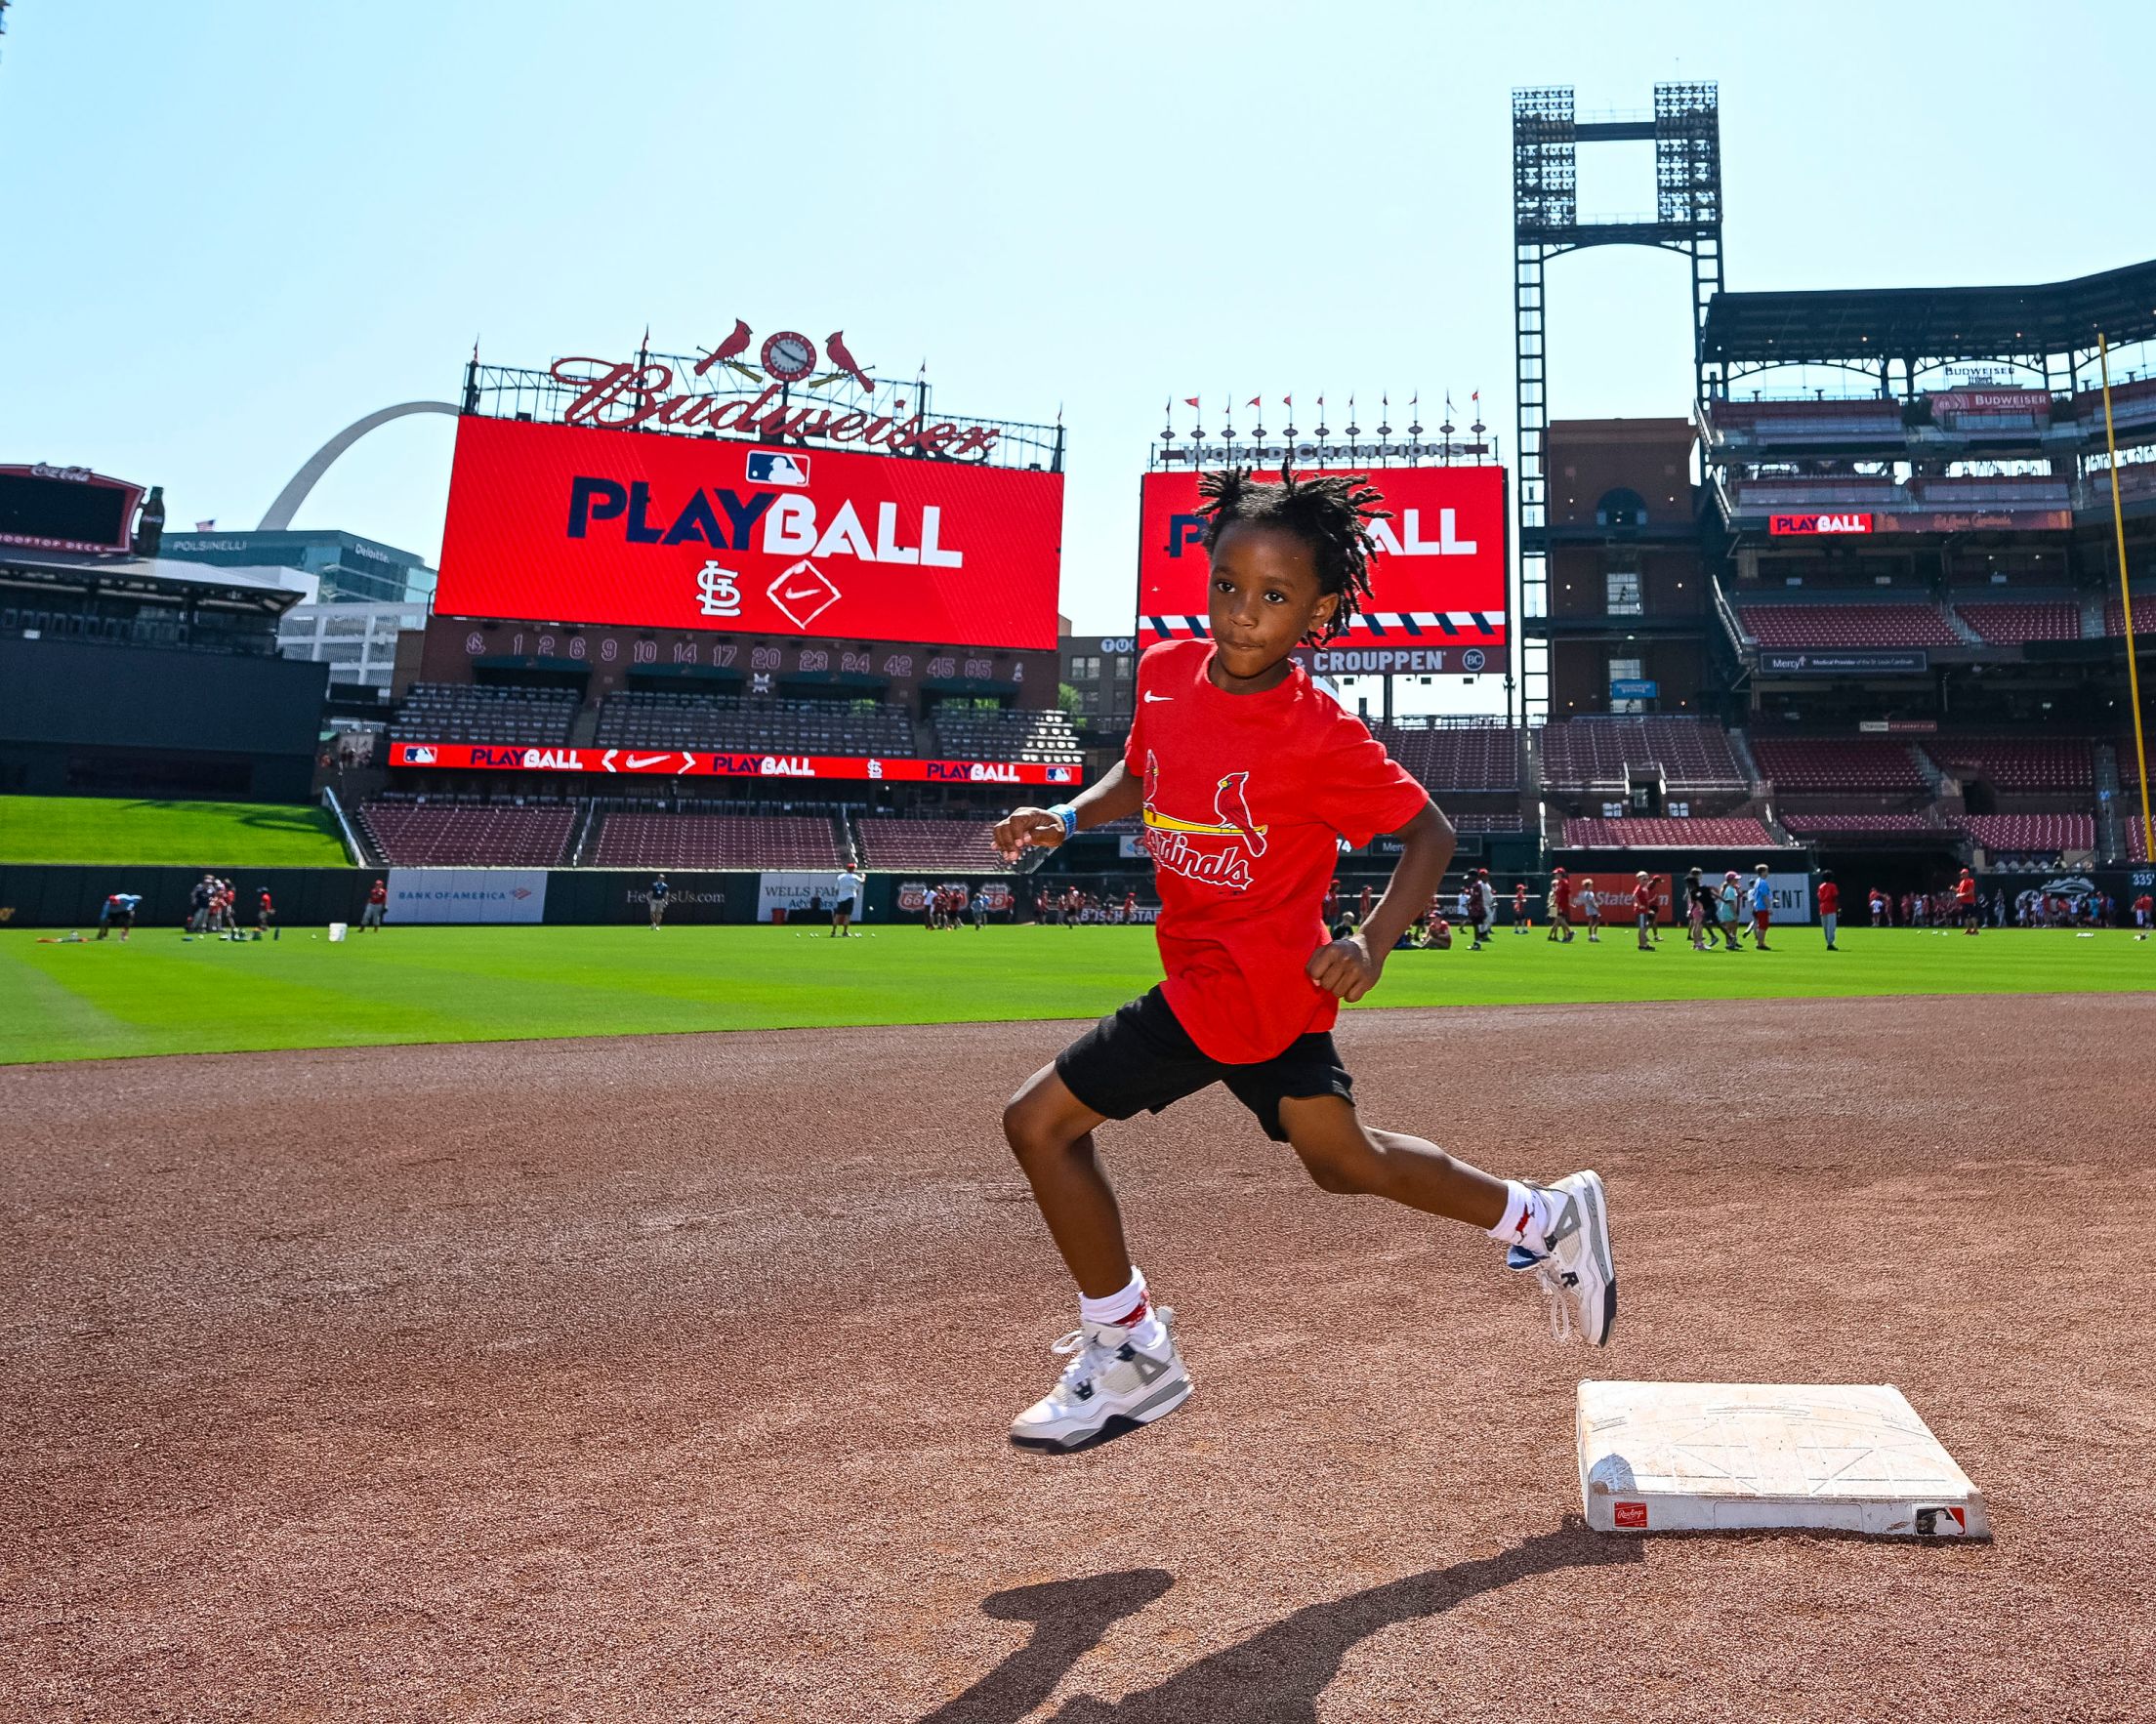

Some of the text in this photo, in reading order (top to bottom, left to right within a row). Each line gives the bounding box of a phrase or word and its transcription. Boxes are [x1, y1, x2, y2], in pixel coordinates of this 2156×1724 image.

[1945, 367, 2014, 376] BUDWEISER
[1975, 394, 2047, 406] BUDWEISER
[551, 356, 1001, 457] Budweiser
[1183, 443, 1466, 464] WORLD CHAMPIONS
[0, 534, 61, 547] OOFTOP
[174, 540, 247, 552] POLSINELLI
[514, 634, 522, 655] 1
[538, 636, 555, 657] 2
[601, 638, 617, 661] 9
[634, 640, 657, 663] 10
[674, 642, 697, 665] 14
[713, 644, 737, 667] 17
[751, 647, 781, 670] 20
[799, 649, 828, 672] 23
[842, 652, 870, 674] 24
[884, 655, 912, 677] 42
[928, 657, 955, 678] 45
[1313, 651, 1443, 671] CROUPPEN
[1772, 658, 1800, 671] Mercy
[1382, 842, 1406, 852] Merc
[398, 890, 506, 900] BANK OF AMERICA
[766, 886, 809, 897] WELLS
[903, 894, 922, 906] 66
[1596, 891, 1633, 906] State
